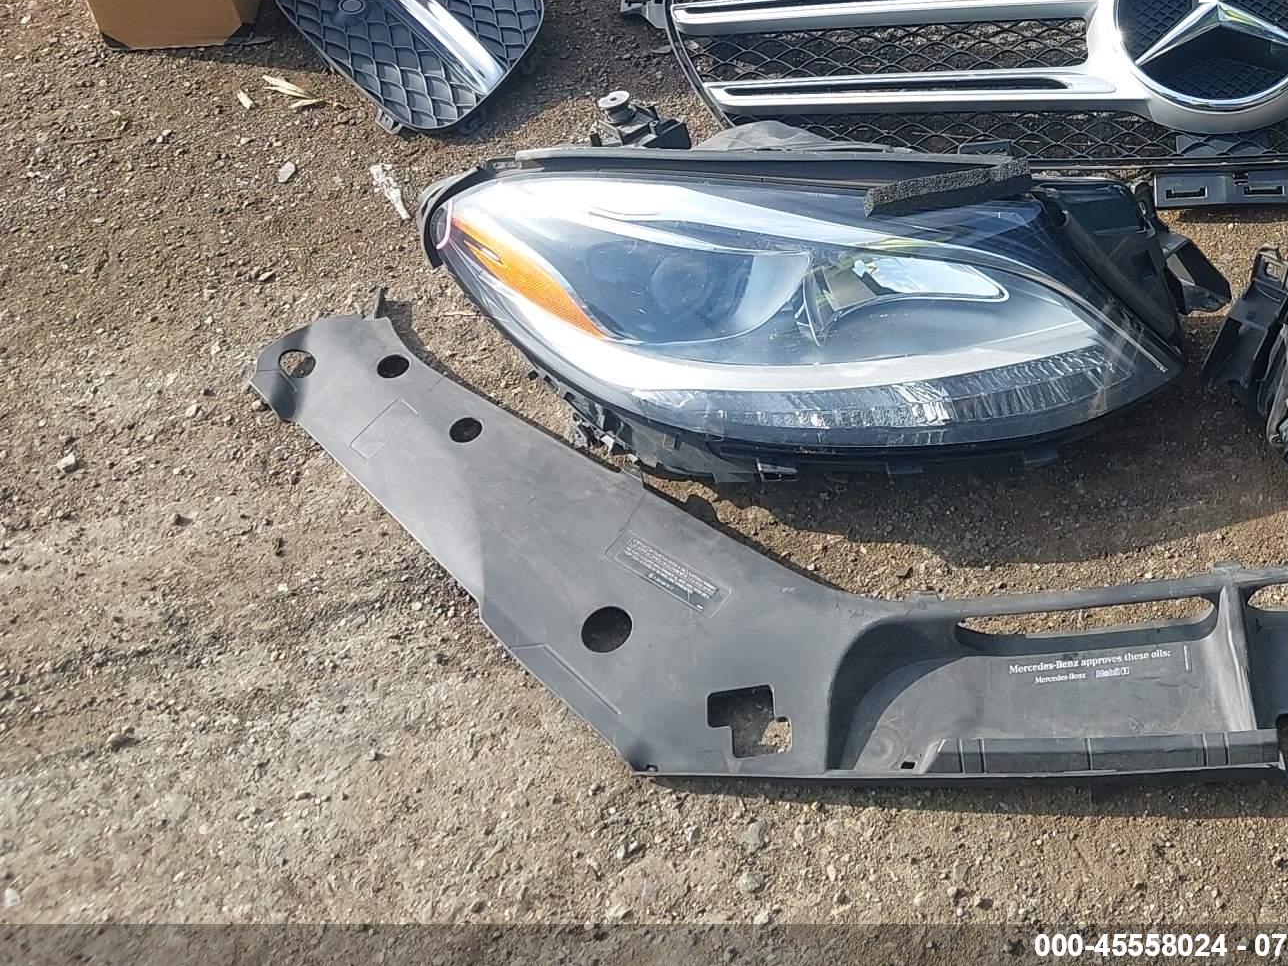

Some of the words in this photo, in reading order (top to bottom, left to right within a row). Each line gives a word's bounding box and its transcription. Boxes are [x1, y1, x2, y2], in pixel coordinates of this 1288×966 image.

[1008, 660, 1079, 674] Mercedes-Benz
[1080, 653, 1122, 667] approves
[1124, 652, 1149, 661] these
[1150, 649, 1171, 659] oils:
[1034, 673, 1087, 684] Mercedes-Benz
